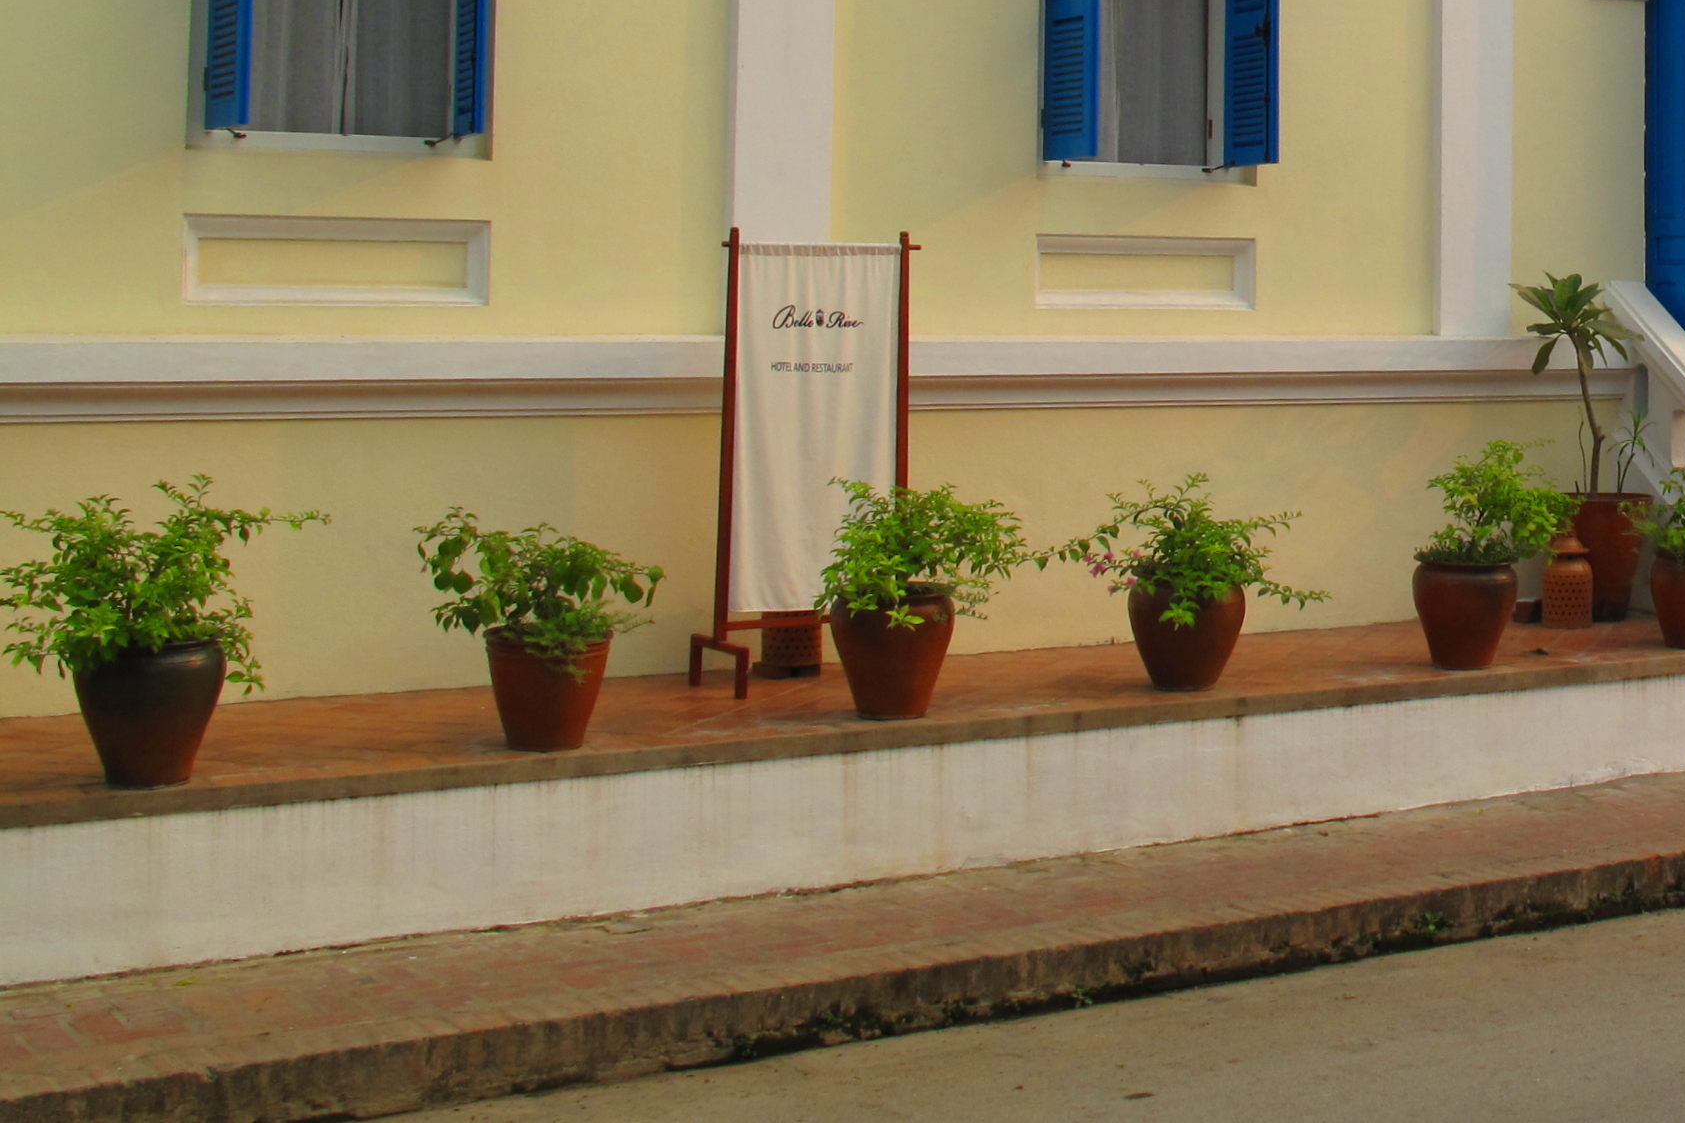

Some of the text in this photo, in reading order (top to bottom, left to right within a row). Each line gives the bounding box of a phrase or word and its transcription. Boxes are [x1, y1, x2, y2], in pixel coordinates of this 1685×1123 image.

[773, 305, 814, 329] Belle
[770, 362, 854, 373] HOTEL AND RESTAURANT
